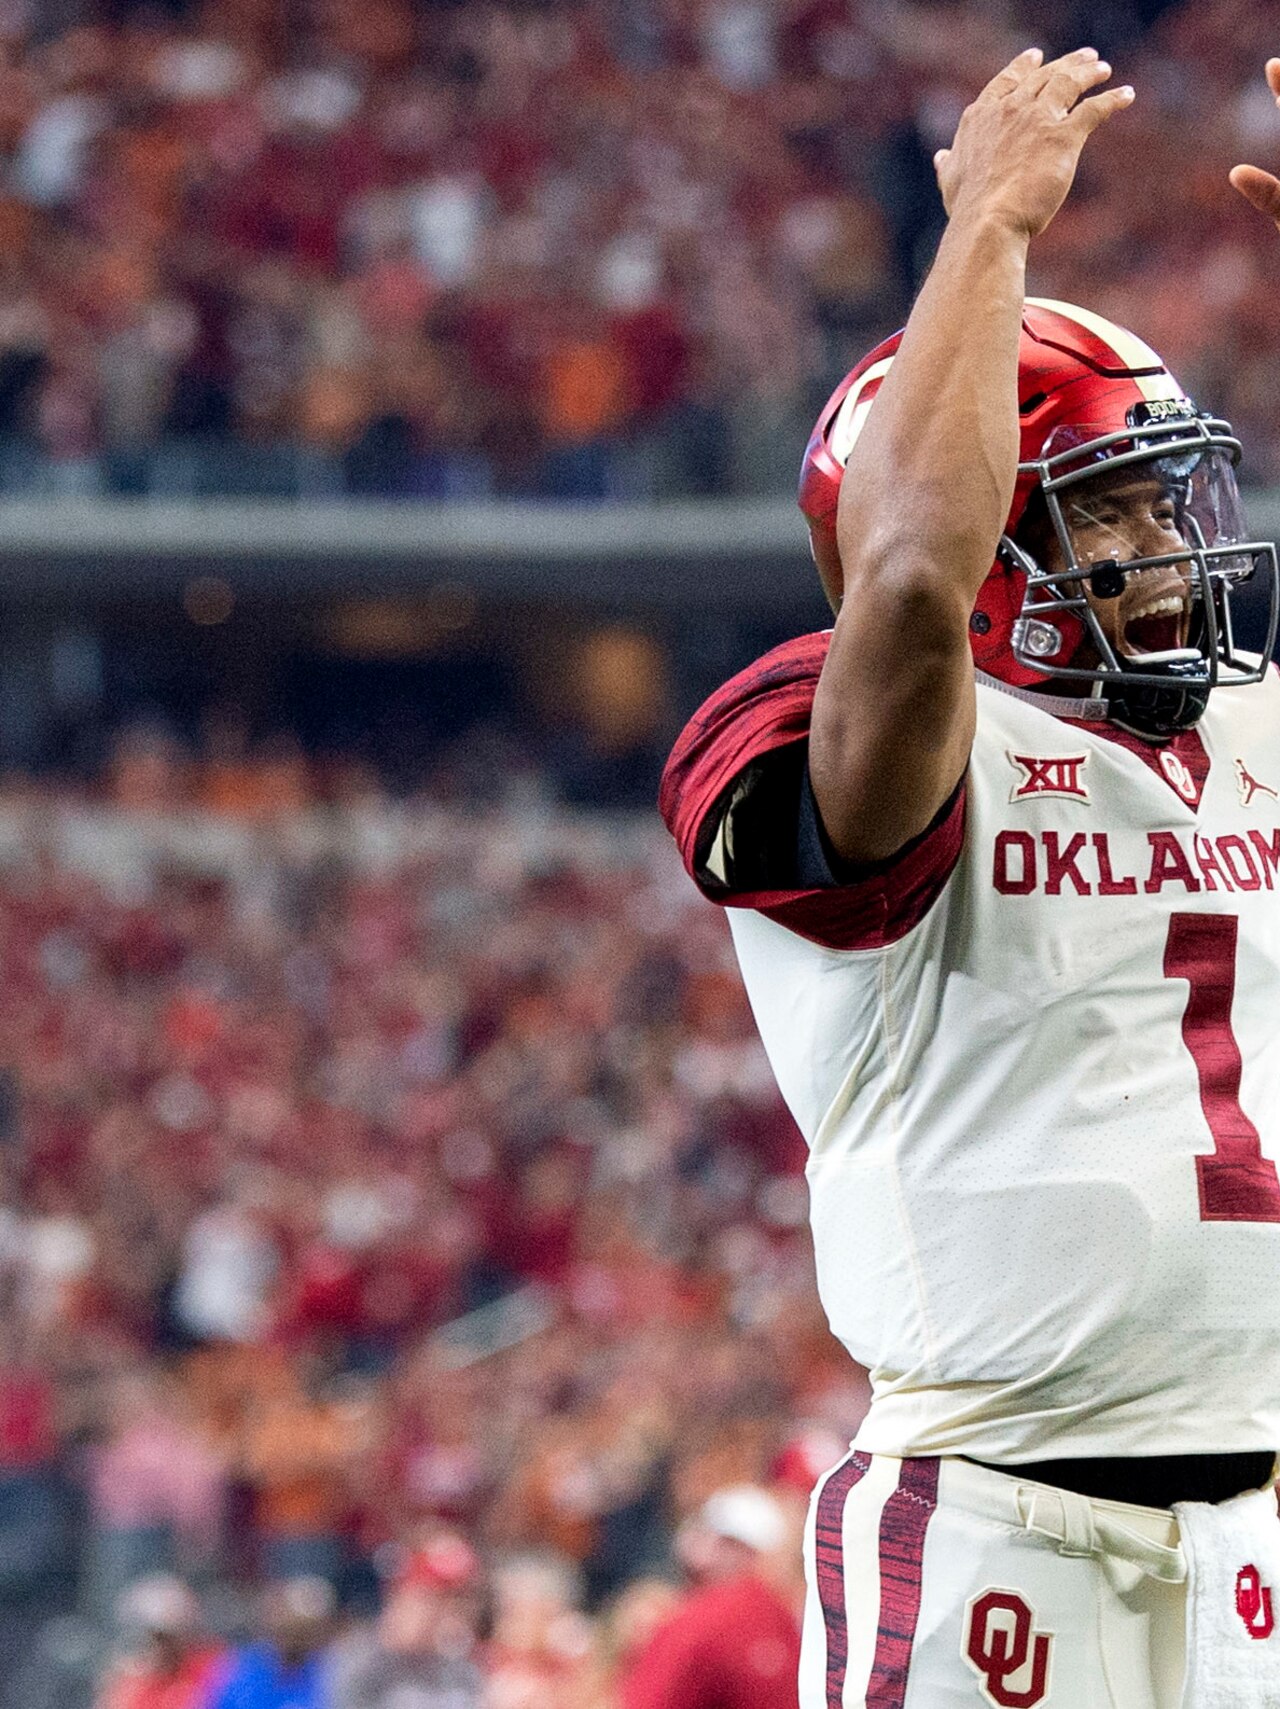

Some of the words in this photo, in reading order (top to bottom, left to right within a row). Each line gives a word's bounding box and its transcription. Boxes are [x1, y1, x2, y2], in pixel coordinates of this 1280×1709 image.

[1014, 755, 1087, 797] XII
[1160, 751, 1197, 799] OU
[1235, 1564, 1275, 1639] OU
[967, 1592, 1050, 1709] OU
